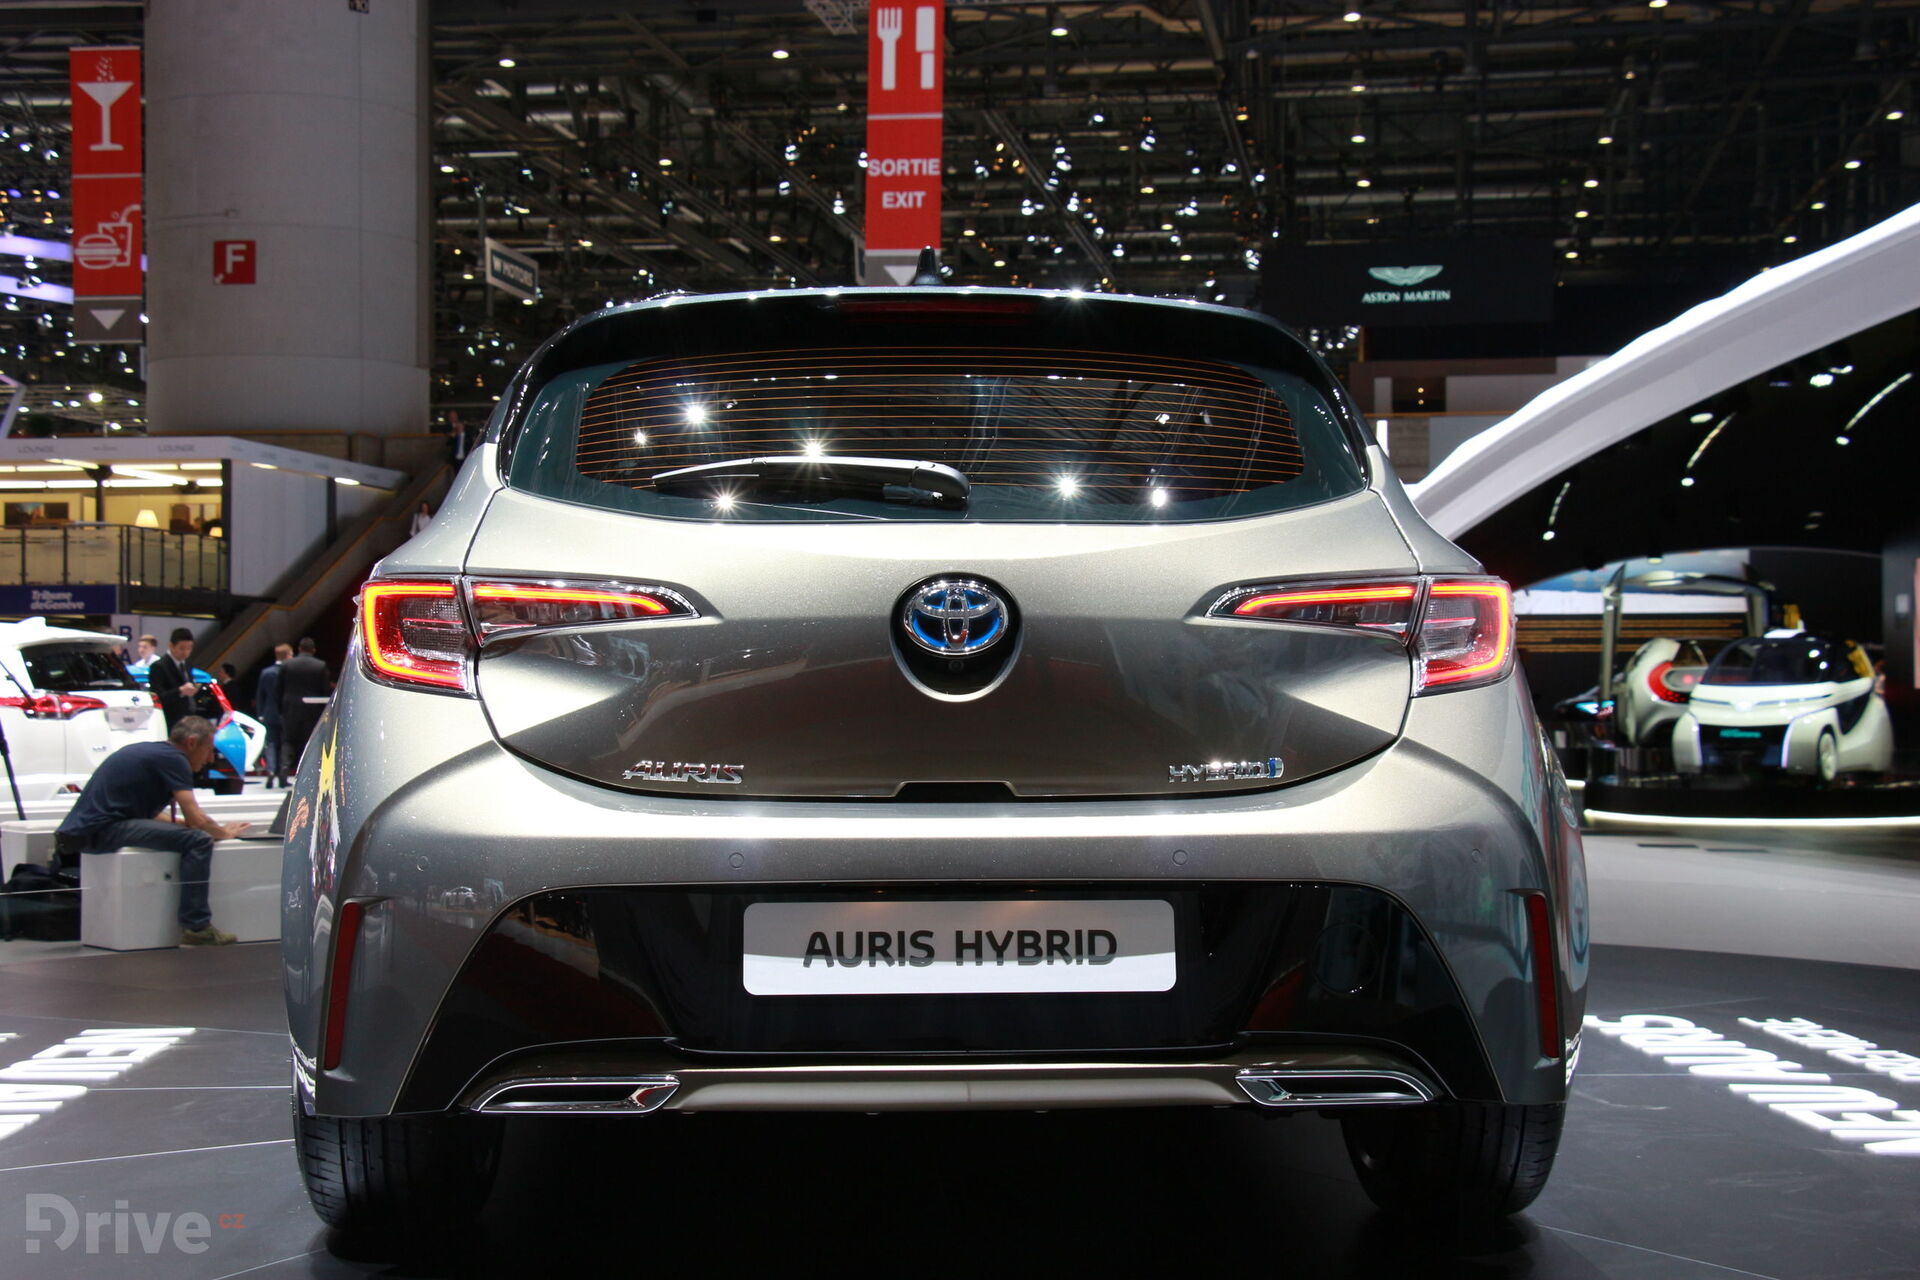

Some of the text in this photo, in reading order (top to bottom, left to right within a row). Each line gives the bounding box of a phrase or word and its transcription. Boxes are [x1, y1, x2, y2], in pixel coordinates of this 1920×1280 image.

[868, 158, 941, 176] SORTIE
[882, 191, 926, 208] EXIT
[226, 243, 247, 273] F
[1361, 289, 1451, 304] ASTON MARTIN
[622, 760, 744, 784] AURIS
[1168, 760, 1269, 783] HYBRID
[803, 929, 1117, 968] AURIS HYBRID
